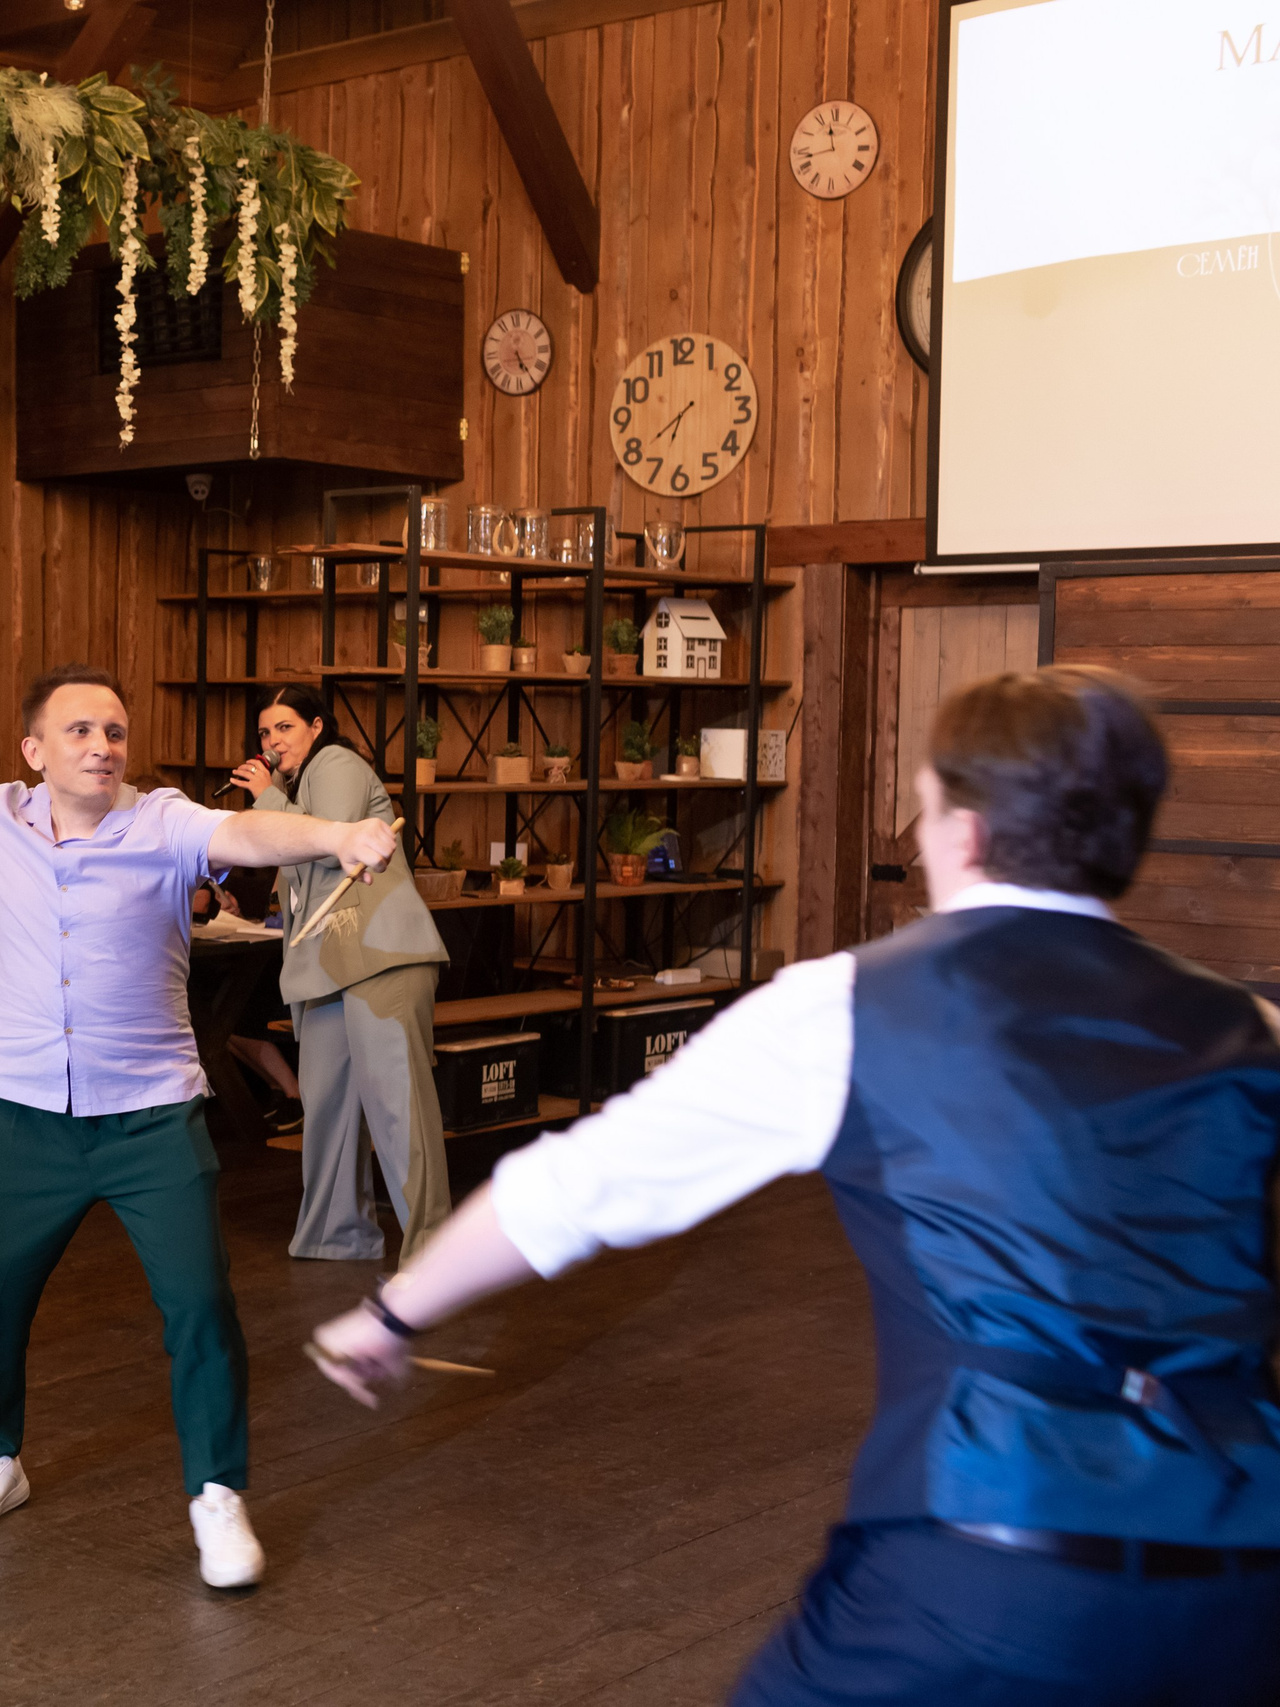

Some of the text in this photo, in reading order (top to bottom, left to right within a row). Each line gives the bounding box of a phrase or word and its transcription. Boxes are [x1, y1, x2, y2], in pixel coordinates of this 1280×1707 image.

[646, 350, 664, 379] 11
[669, 337, 695, 366] 12
[705, 342, 714, 371] 1
[623, 376, 650, 405] 10
[724, 363, 742, 392] 2
[613, 406, 632, 434] 9
[733, 395, 752, 424] 3
[623, 437, 643, 466] 8
[721, 430, 740, 457] 4
[646, 457, 664, 485] 7
[670, 464, 690, 492] 6
[700, 452, 719, 481] 5
[645, 1030, 687, 1056] LOFT
[482, 1060, 517, 1083] LOFT
